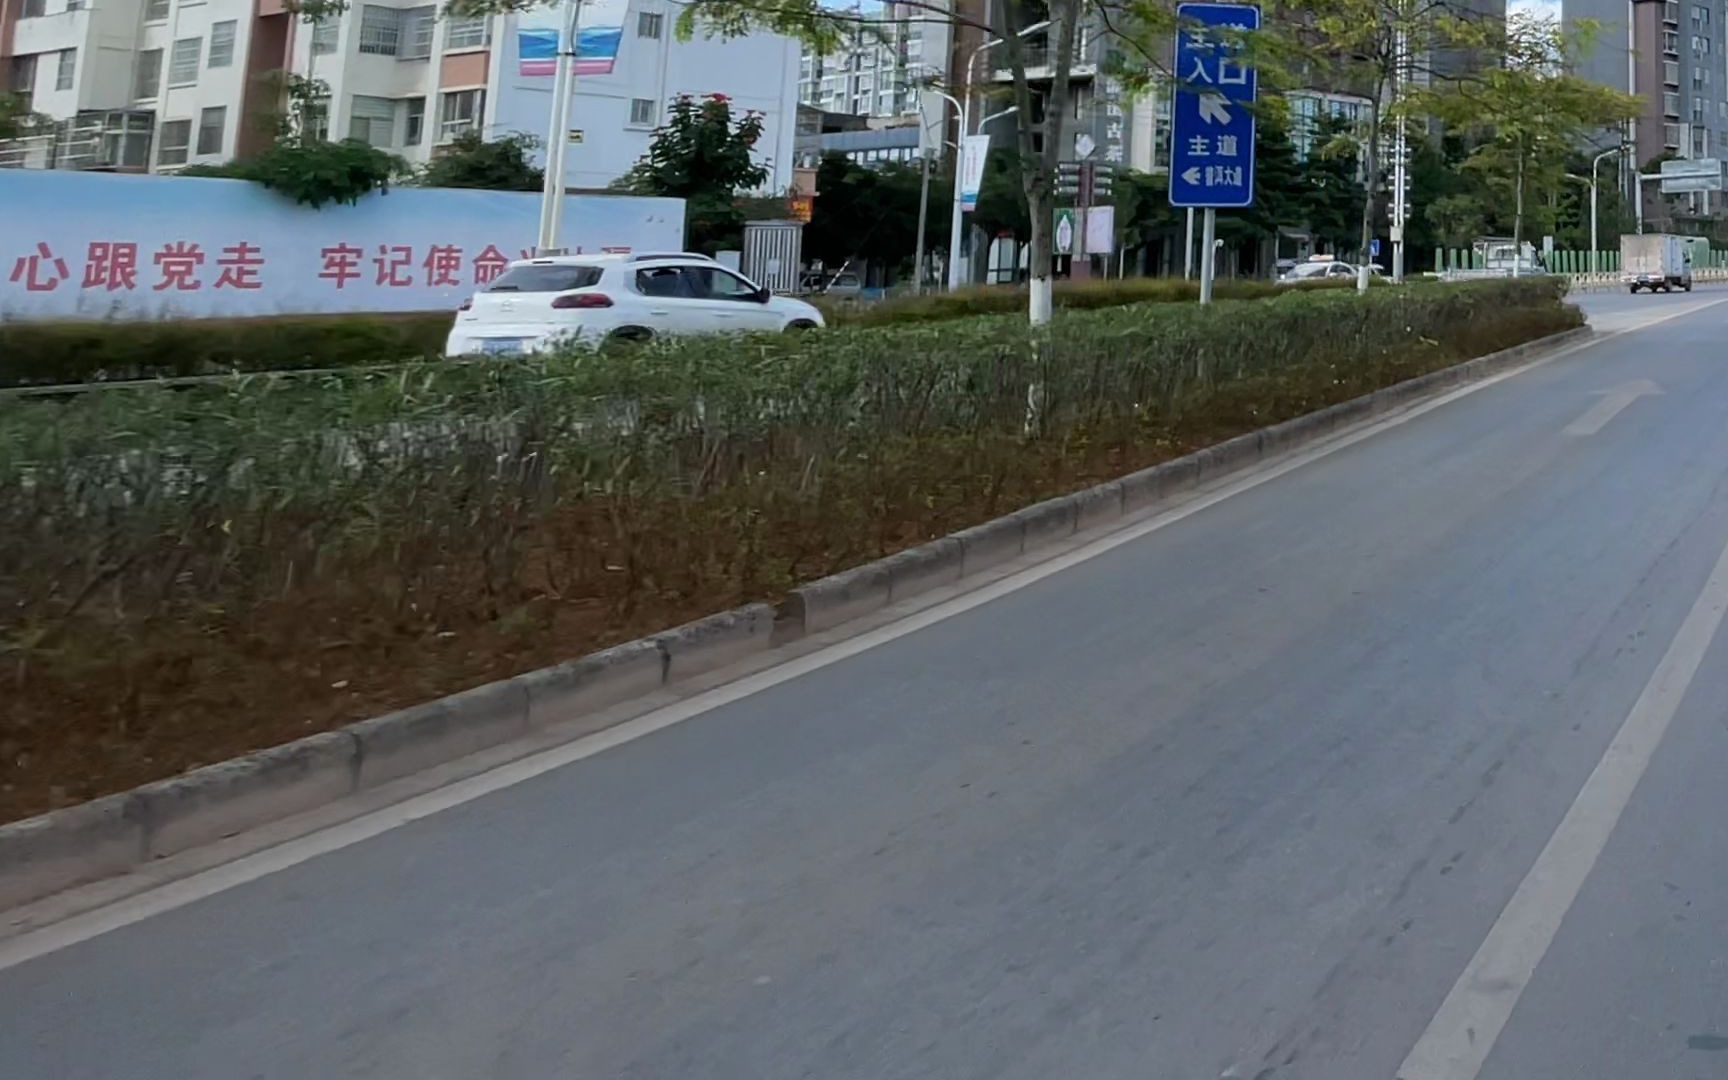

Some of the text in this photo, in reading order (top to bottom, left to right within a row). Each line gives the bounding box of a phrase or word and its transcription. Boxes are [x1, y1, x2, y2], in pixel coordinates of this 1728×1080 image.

[1185, 56, 1248, 85] 入口
[1187, 134, 1238, 157] 主道
[9, 241, 266, 291] 心跟党走
